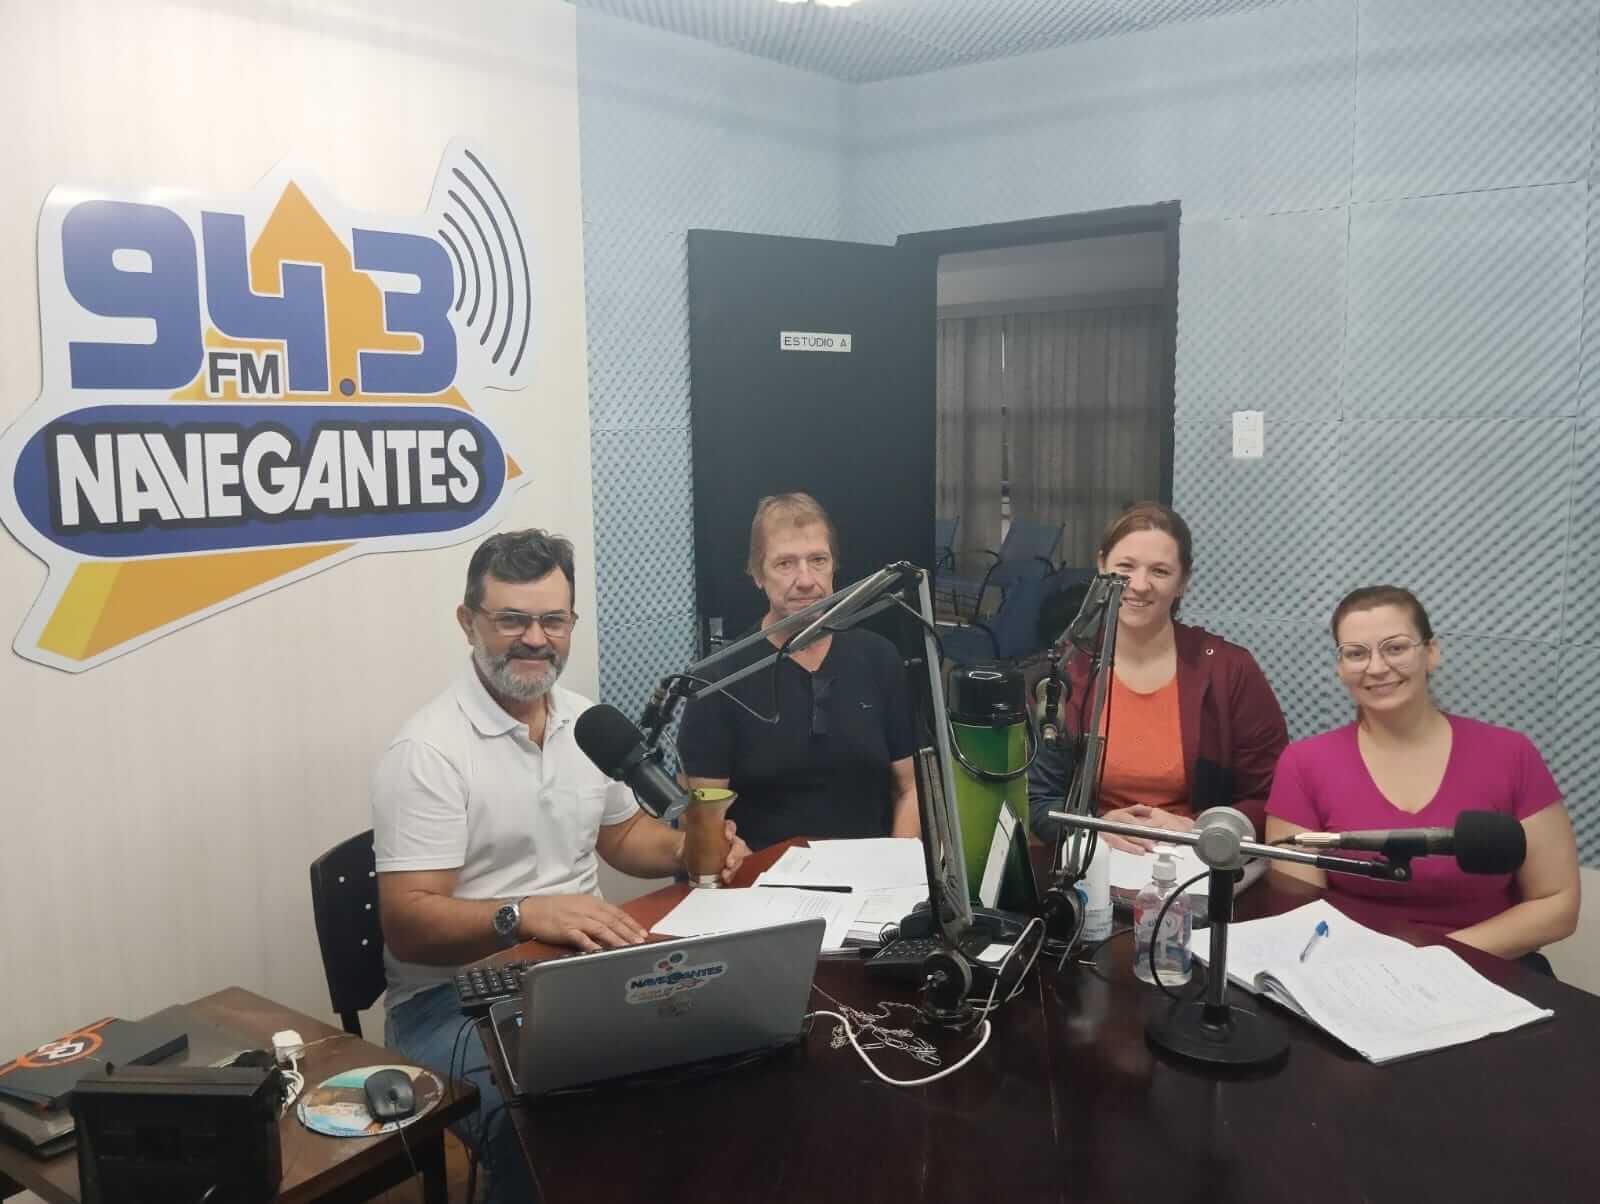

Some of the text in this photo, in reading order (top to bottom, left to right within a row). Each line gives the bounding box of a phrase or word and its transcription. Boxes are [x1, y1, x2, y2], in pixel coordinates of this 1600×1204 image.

[61, 199, 458, 395] 94.3
[208, 352, 281, 394] FM
[840, 338, 847, 347] A
[55, 428, 480, 527] NAVEGANTES
